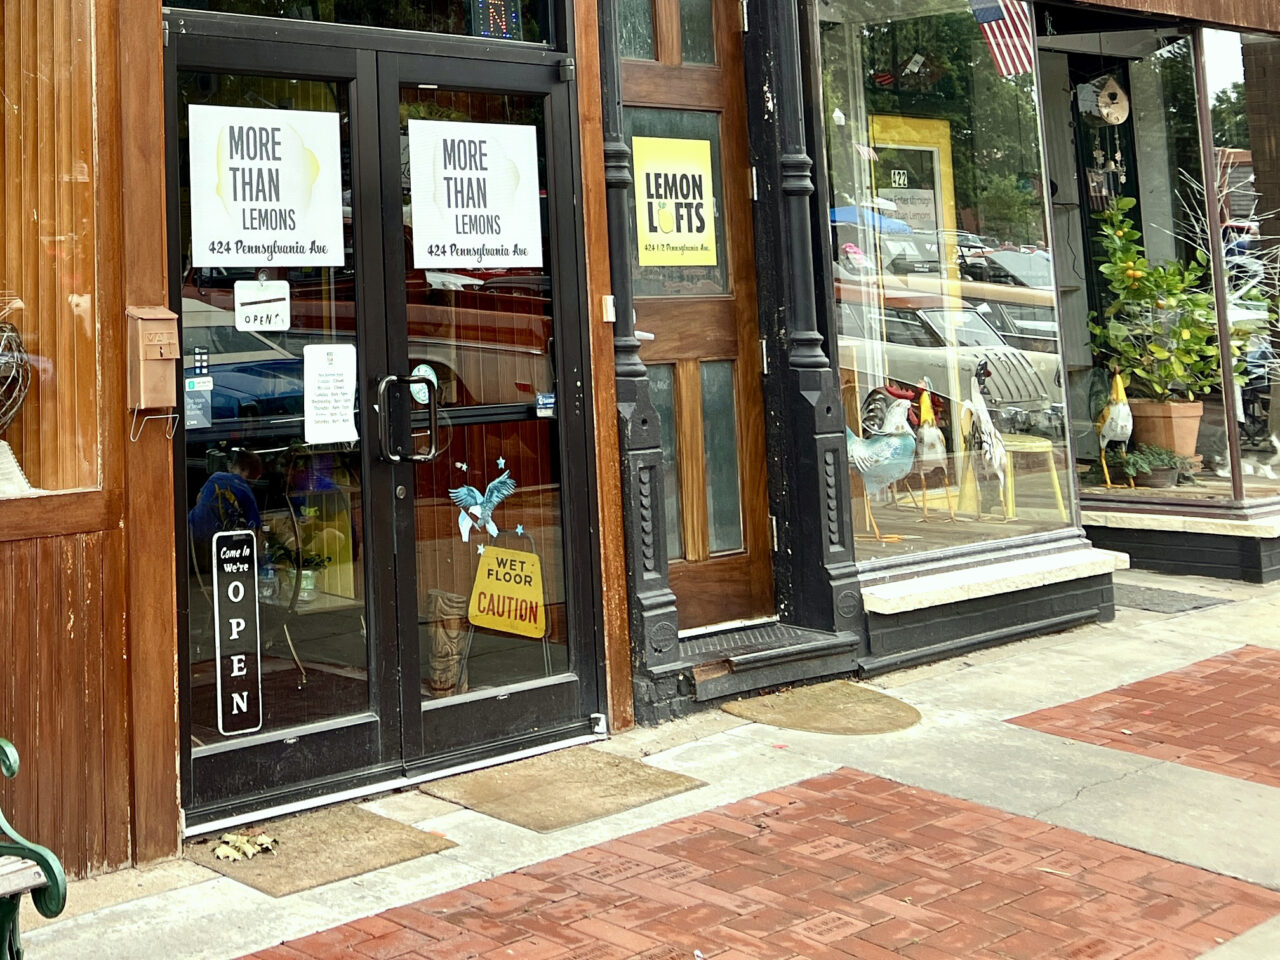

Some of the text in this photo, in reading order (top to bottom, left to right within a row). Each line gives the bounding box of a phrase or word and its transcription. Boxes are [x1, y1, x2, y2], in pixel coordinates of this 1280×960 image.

[229, 126, 282, 161] MORE
[442, 139, 488, 171] MORE
[229, 167, 280, 202] THAN
[646, 173, 703, 200] LEMON
[891, 170, 907, 187] 422
[443, 177, 488, 209] THAN
[242, 208, 296, 231] LEMONS
[455, 214, 501, 235] LEMONS
[208, 239, 328, 261] 424 Pennsylvania Ave
[427, 243, 528, 263] 424 Pennsylvania Ave
[220, 545, 250, 559] Come In
[223, 562, 249, 573] We're
[496, 557, 526, 572] WET
[487, 569, 533, 587] FLOOR
[477, 591, 538, 624] CAUTION
[227, 581, 249, 714] OPEN
